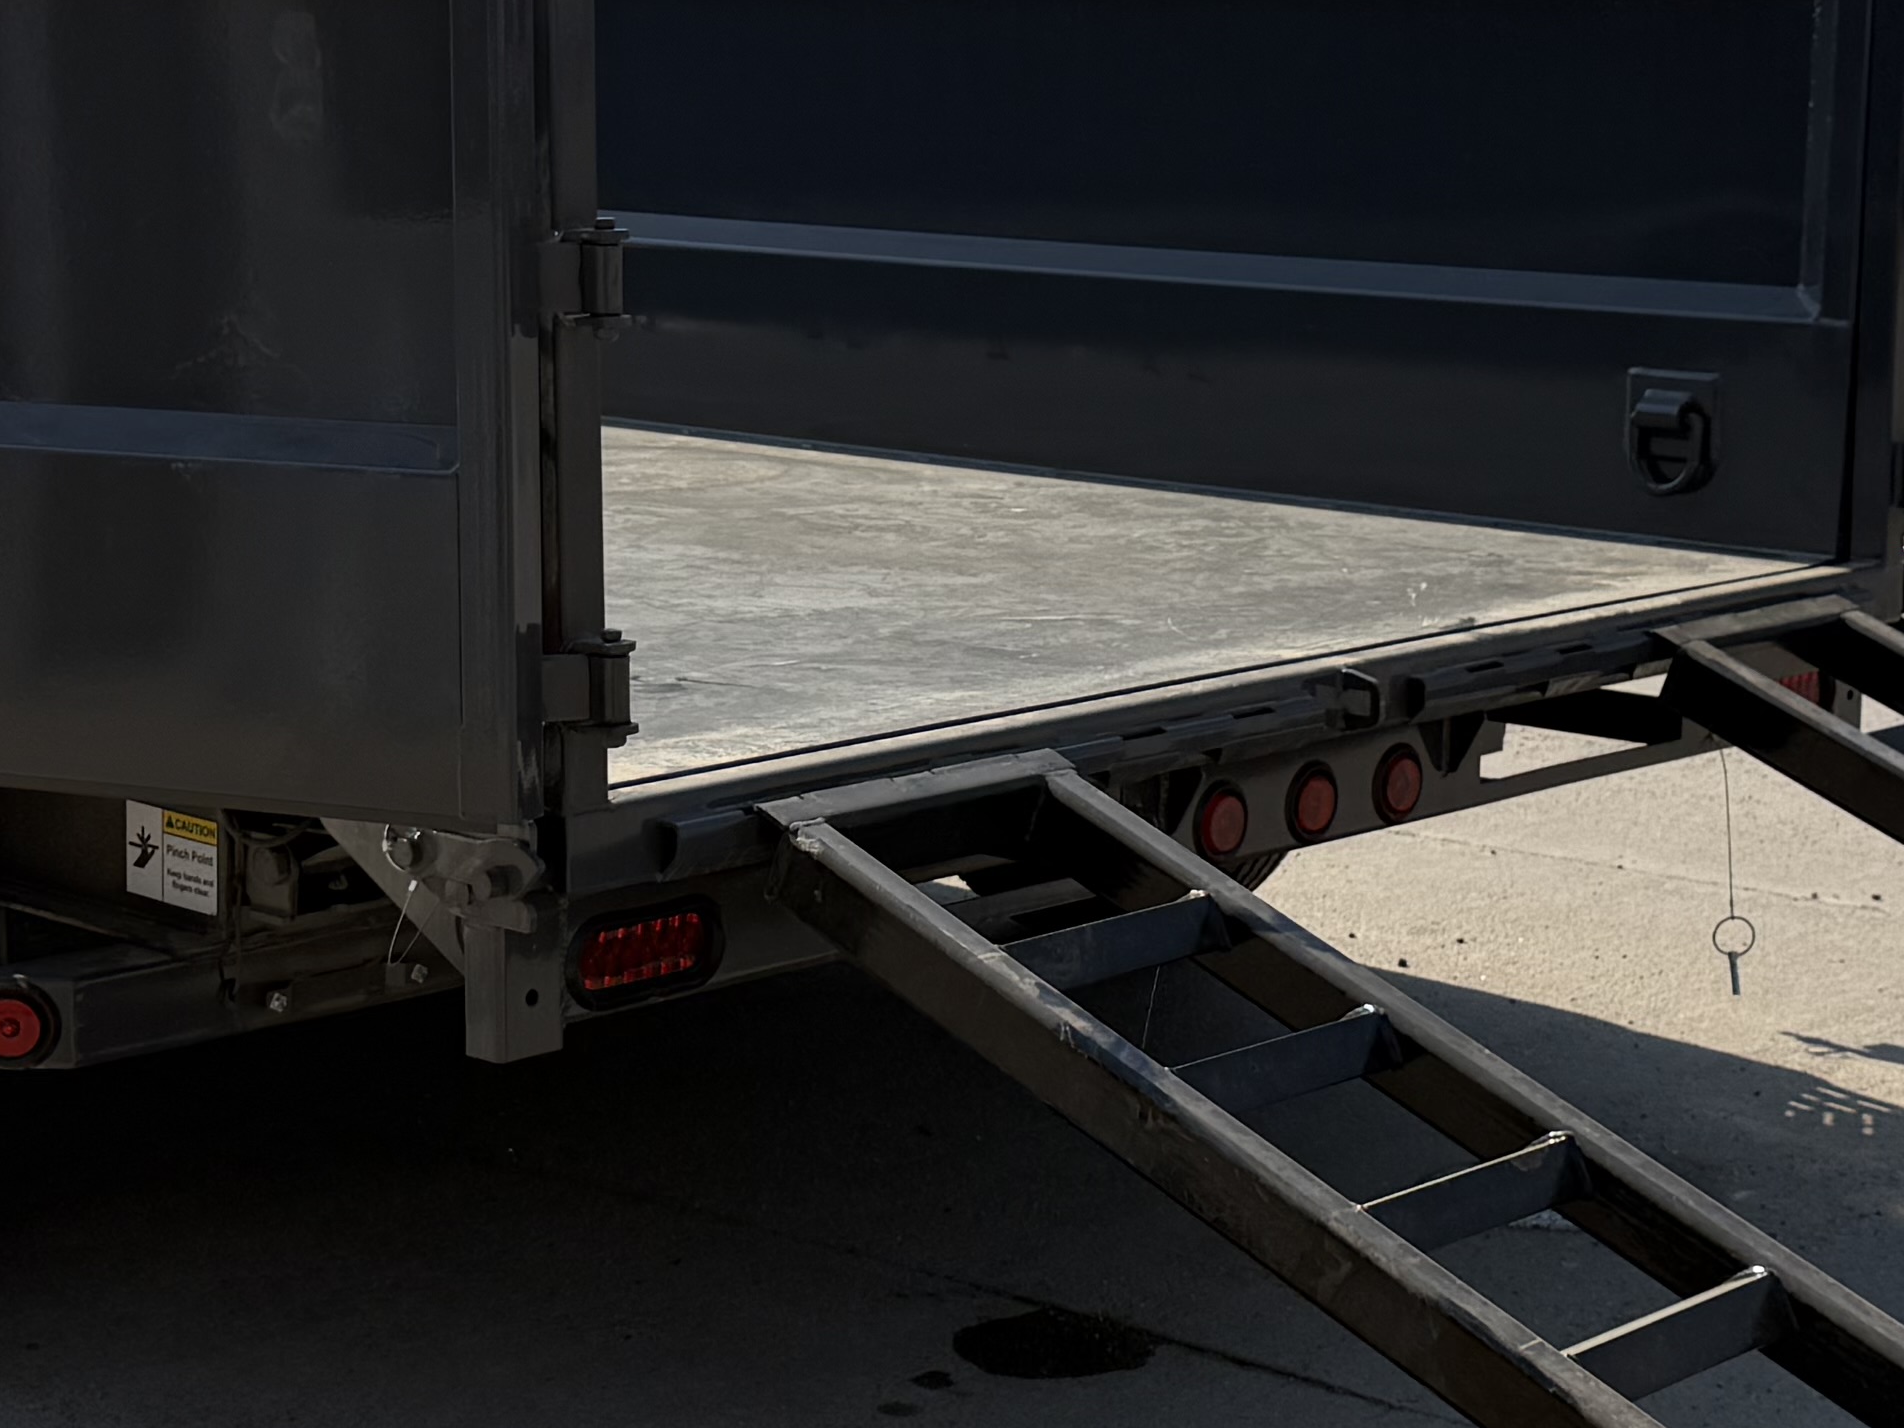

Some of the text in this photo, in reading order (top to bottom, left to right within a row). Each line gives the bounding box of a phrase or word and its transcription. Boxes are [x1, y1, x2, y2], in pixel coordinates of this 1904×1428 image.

[175, 819, 216, 838] CAUTION
[166, 843, 214, 867] Pinch Point
